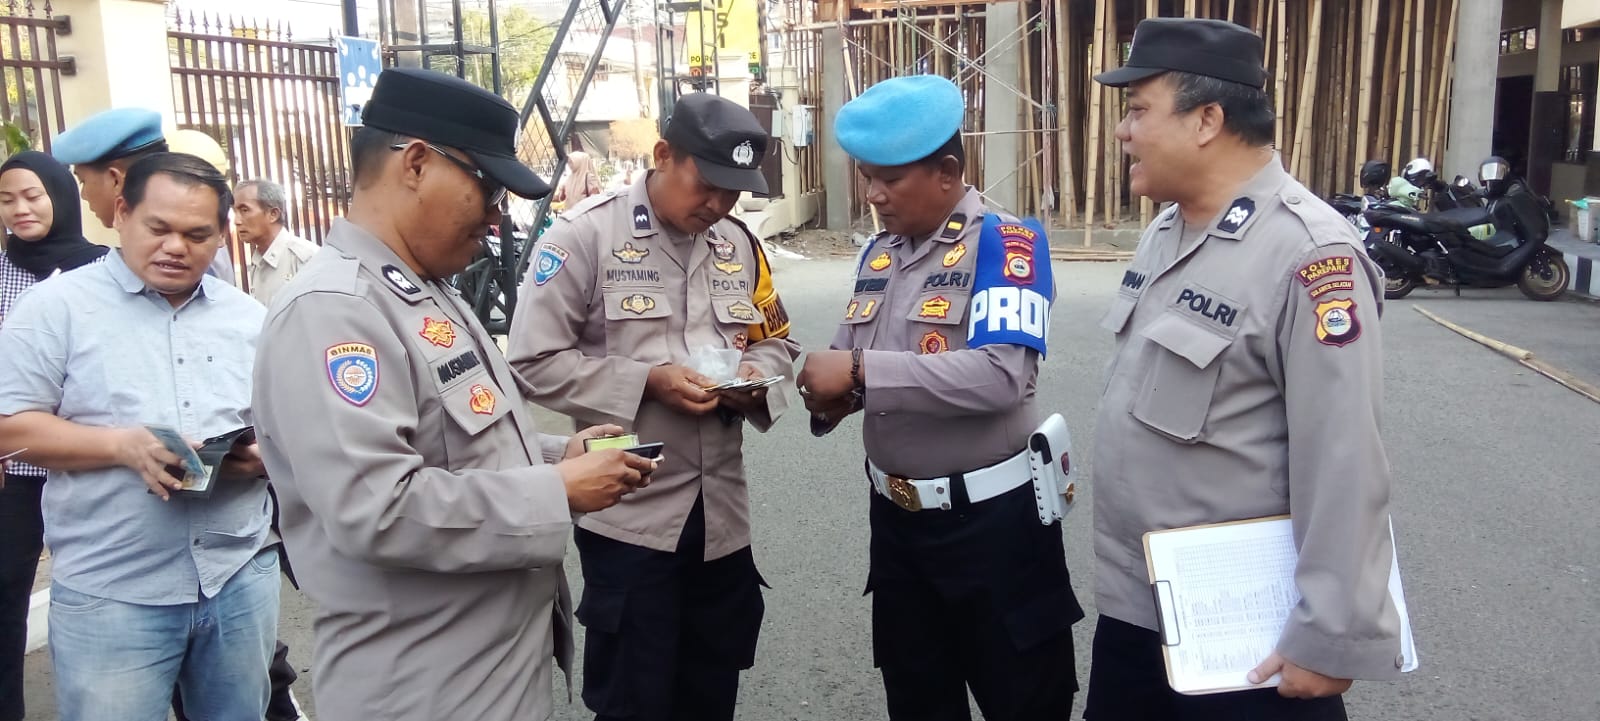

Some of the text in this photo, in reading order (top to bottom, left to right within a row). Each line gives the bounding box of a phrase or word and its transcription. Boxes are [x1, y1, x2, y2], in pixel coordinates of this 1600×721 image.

[606, 269, 660, 282] MUSTAMING
[1300, 258, 1350, 278] POLRES
[1306, 264, 1347, 281] PAREPARE
[712, 279, 749, 292] POLRI
[923, 271, 971, 289] POLRI
[1175, 288, 1238, 327] POLRI
[331, 345, 373, 356] BINMAS
